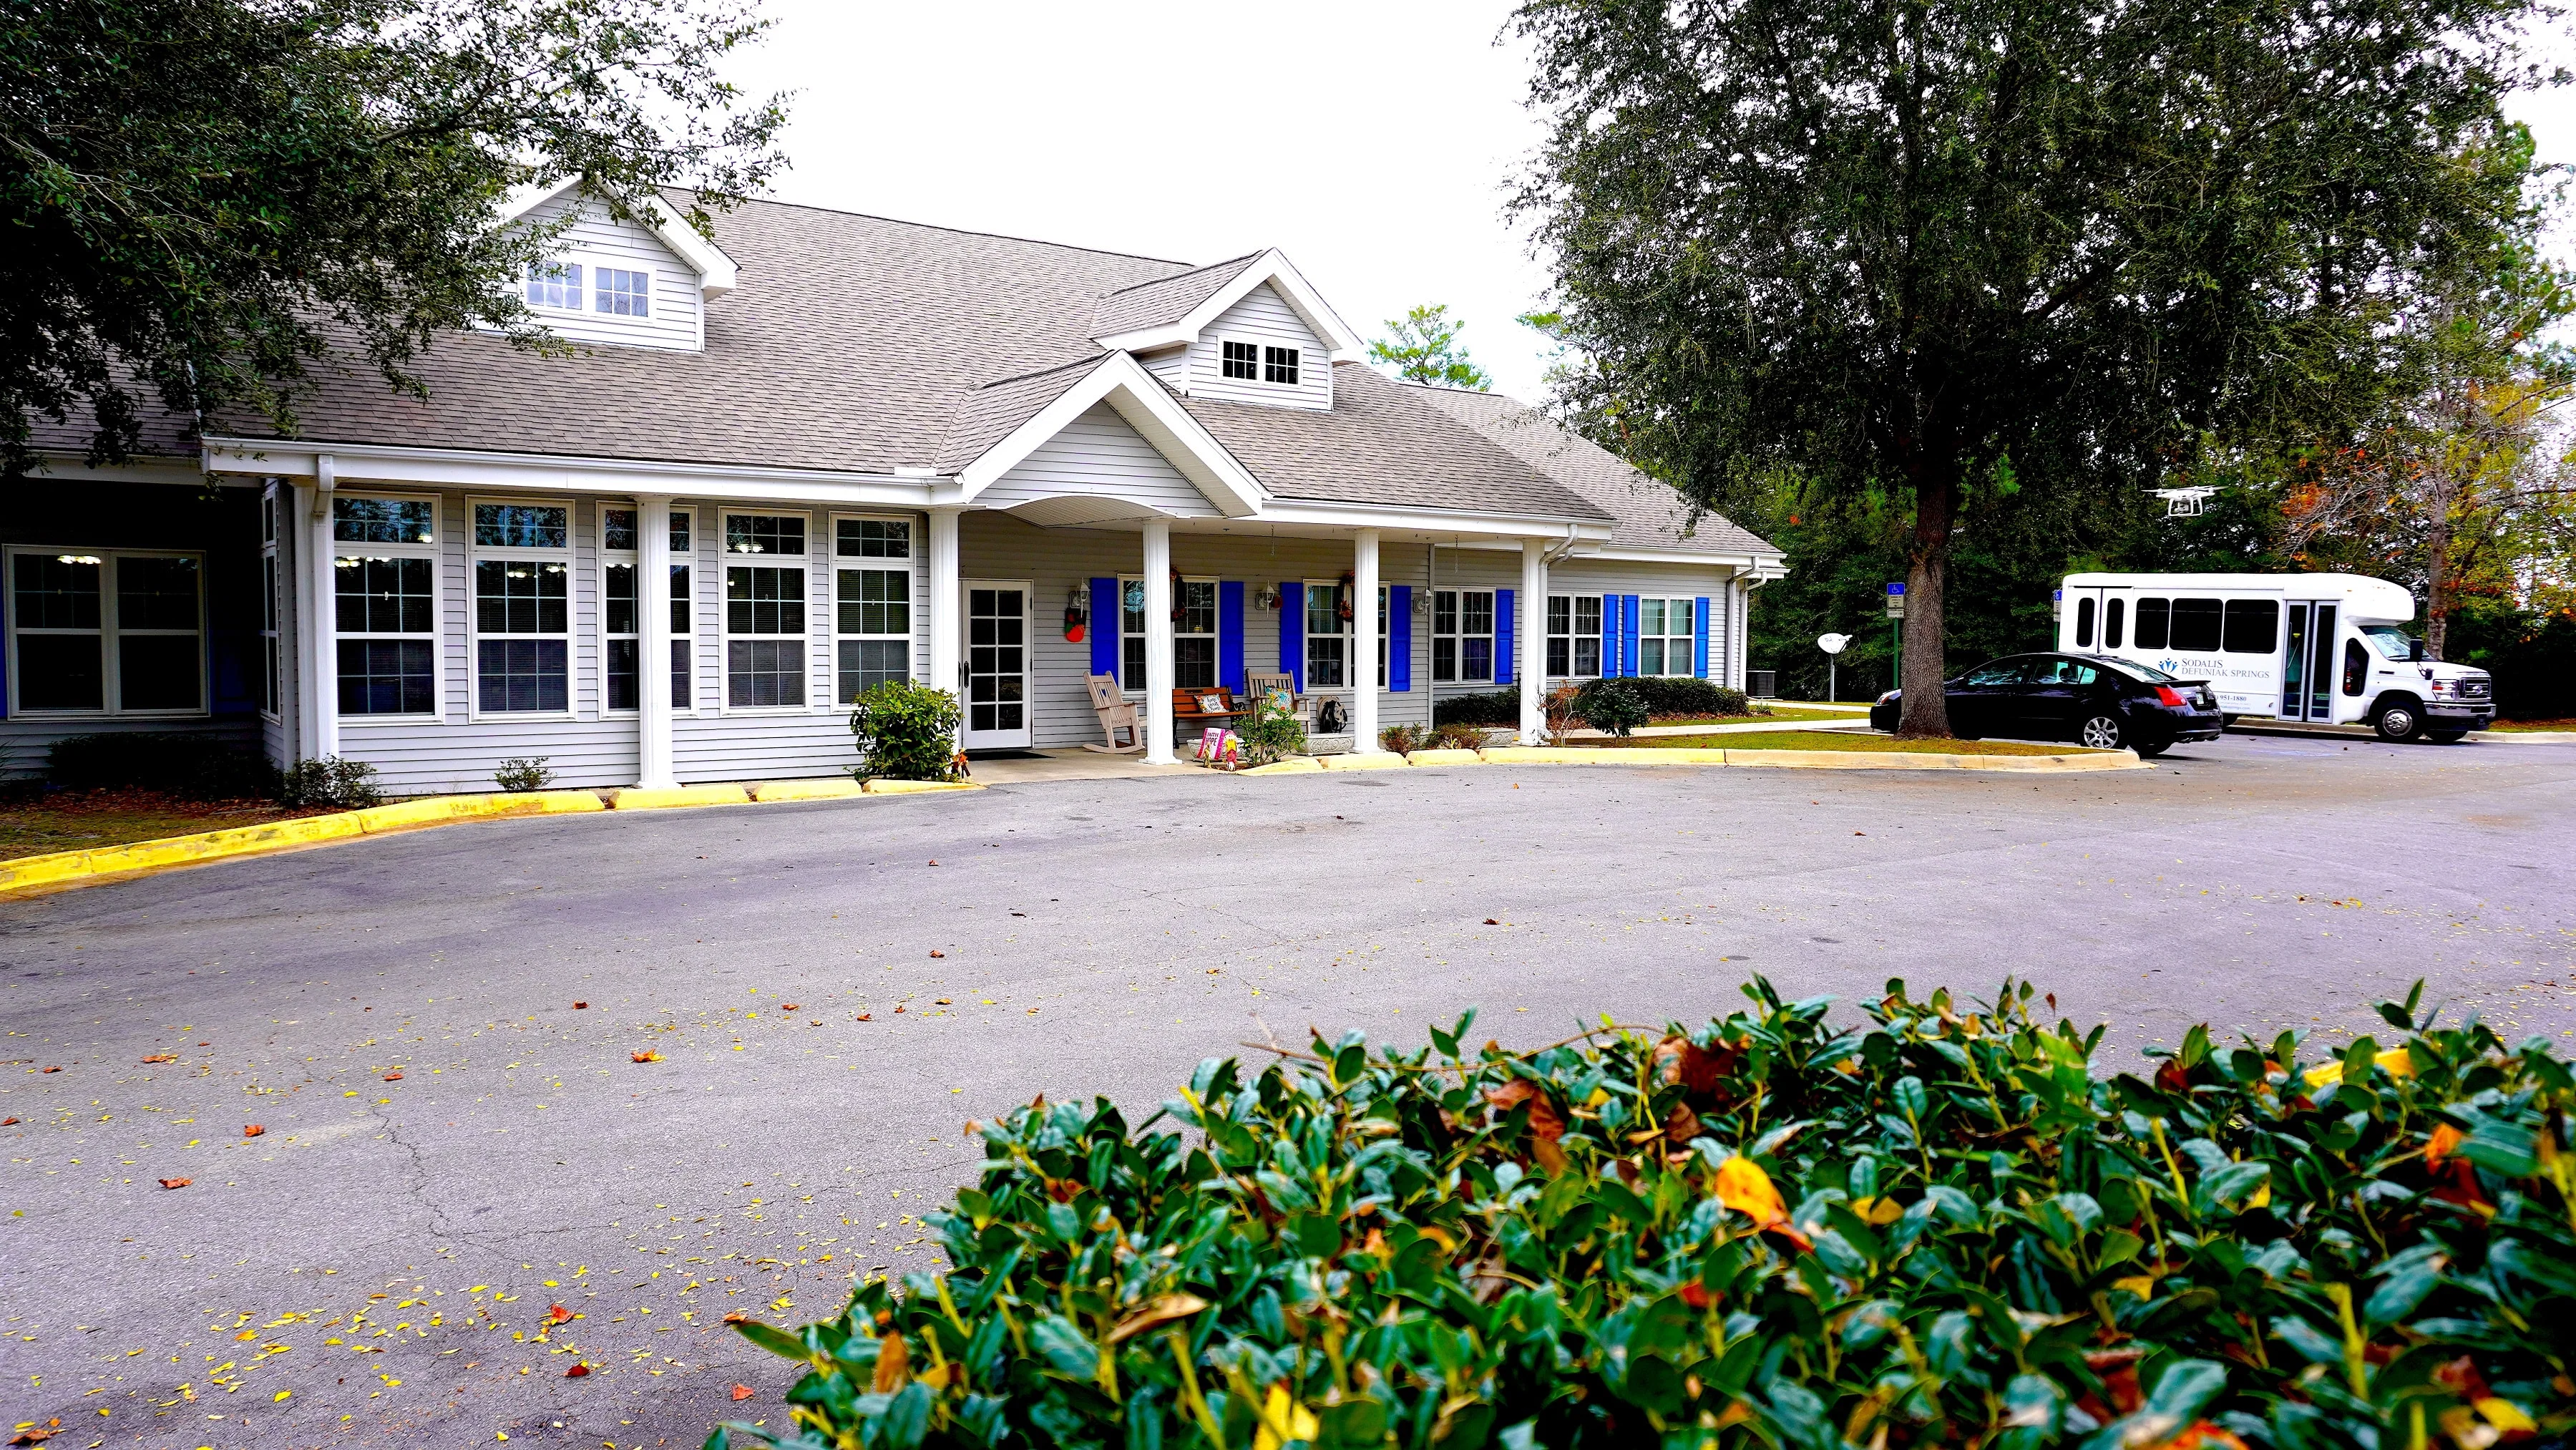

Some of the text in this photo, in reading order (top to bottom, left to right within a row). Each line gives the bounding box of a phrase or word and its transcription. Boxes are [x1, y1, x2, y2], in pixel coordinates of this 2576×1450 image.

[2182, 658, 2223, 668] SODALIS
[2182, 668, 2270, 678] DEFUNIAK SPRINGS
[1205, 737, 1217, 746] HOPE
